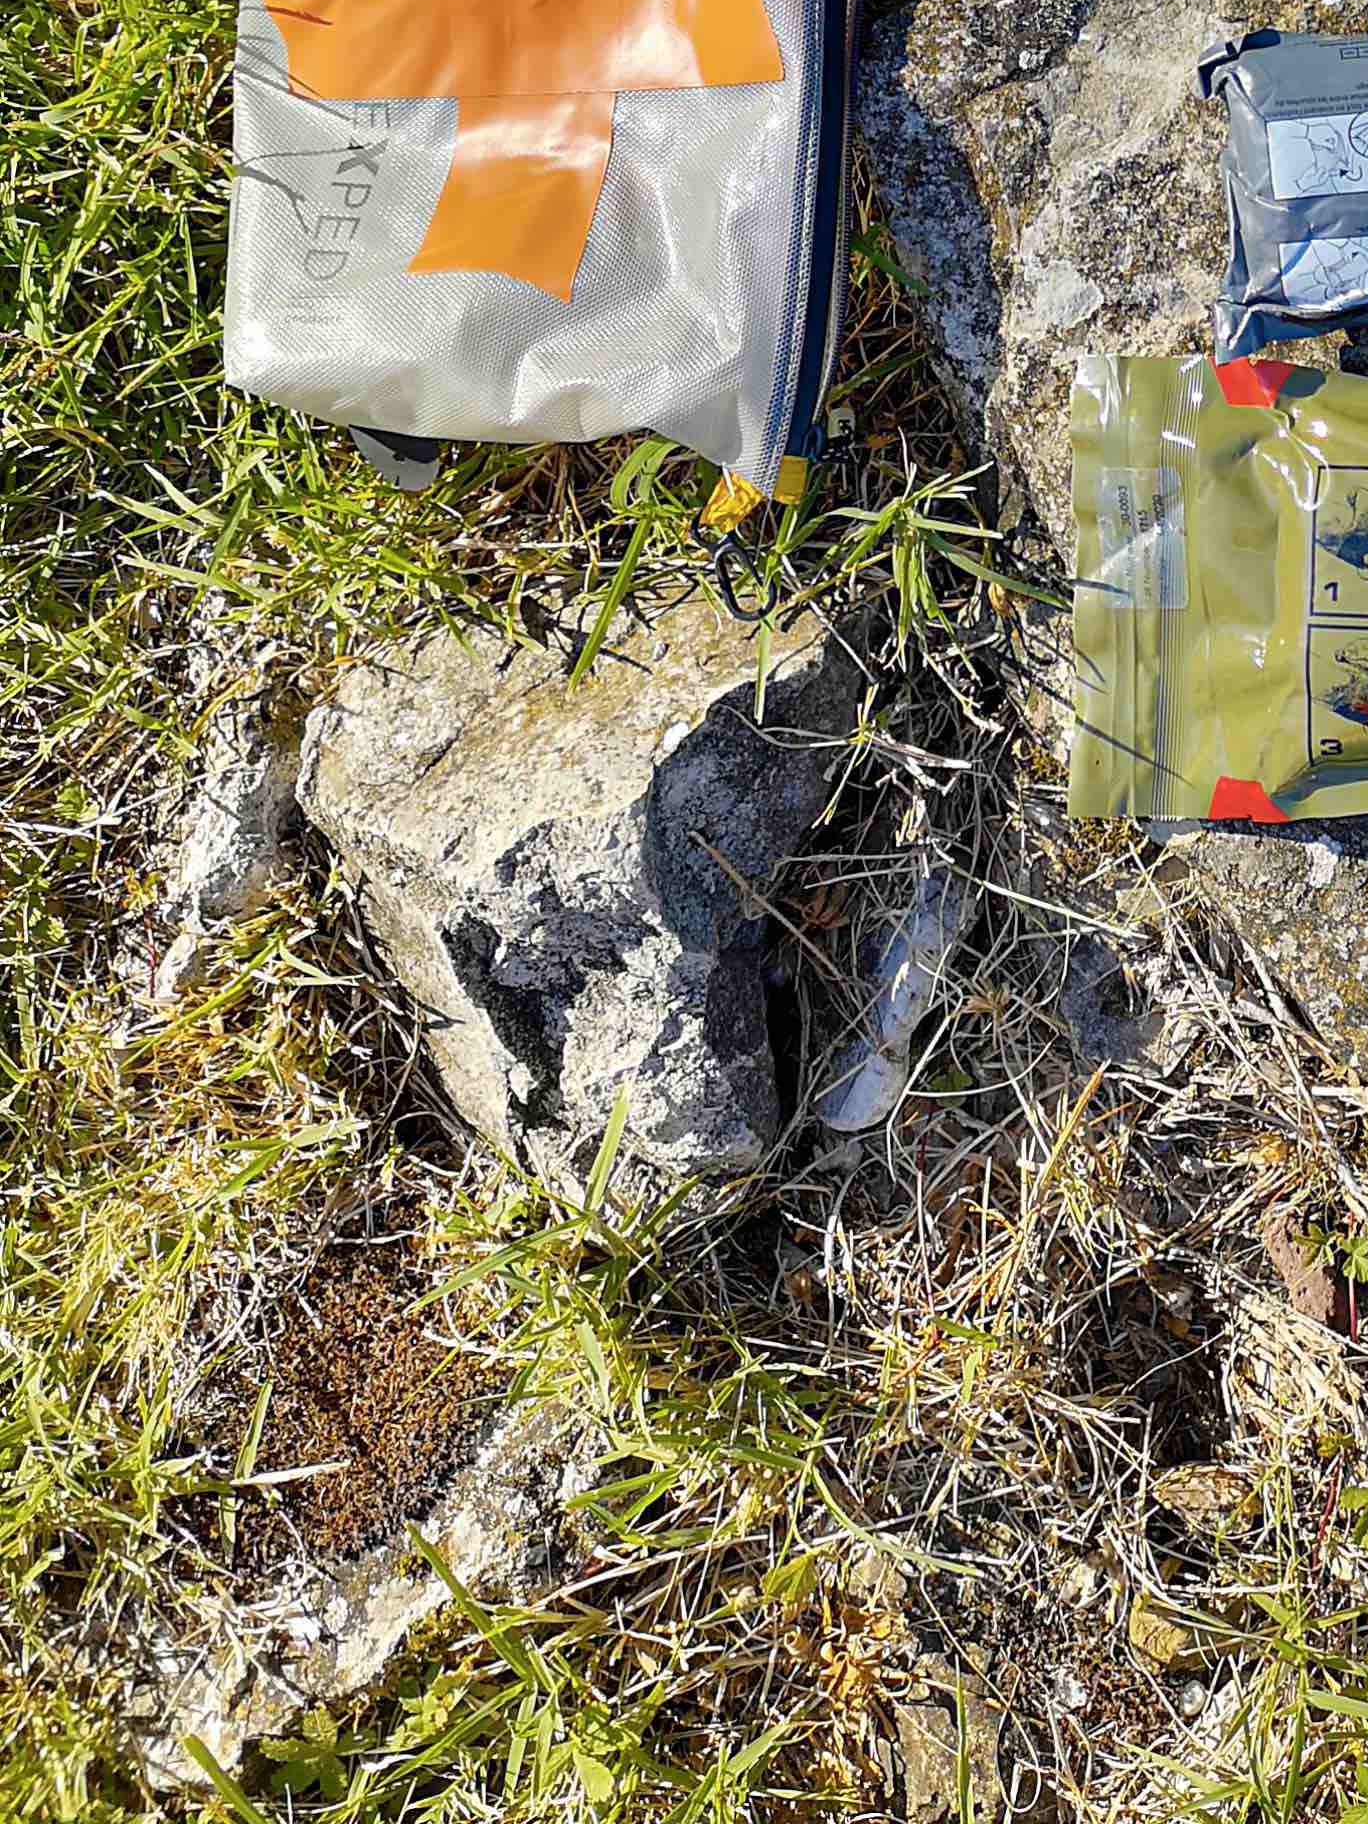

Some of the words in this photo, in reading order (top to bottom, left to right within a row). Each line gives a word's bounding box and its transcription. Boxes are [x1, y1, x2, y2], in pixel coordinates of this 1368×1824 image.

[302, 102, 391, 281] EXPED
[1324, 581, 1338, 601] 1
[1320, 738, 1343, 756] 3
